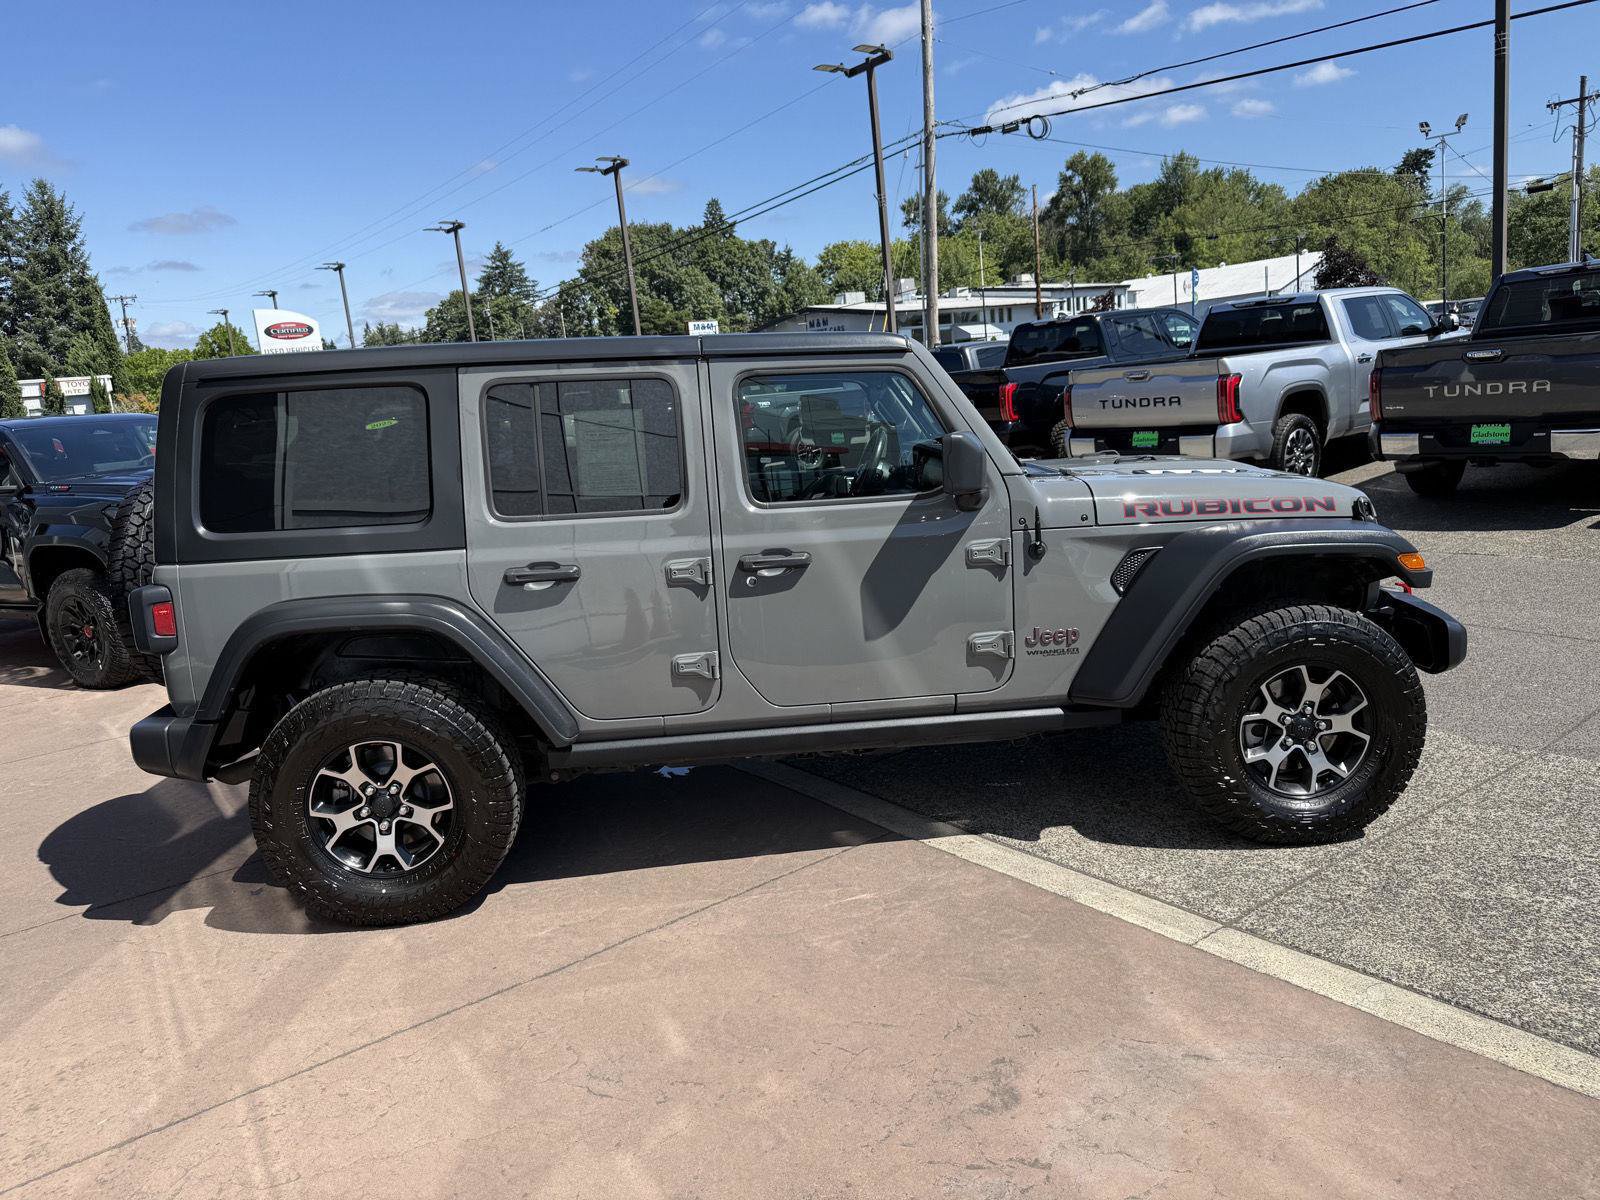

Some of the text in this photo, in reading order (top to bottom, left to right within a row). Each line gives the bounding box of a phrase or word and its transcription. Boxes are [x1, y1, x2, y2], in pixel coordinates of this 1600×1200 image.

[1424, 380, 1551, 398] TUNDRA
[1099, 396, 1181, 409] TUNDRA
[1472, 430, 1510, 438] Gladstone
[1124, 496, 1337, 518] RUBICON
[1025, 626, 1079, 648] Jeep
[1026, 647, 1080, 656] WRANGLER
